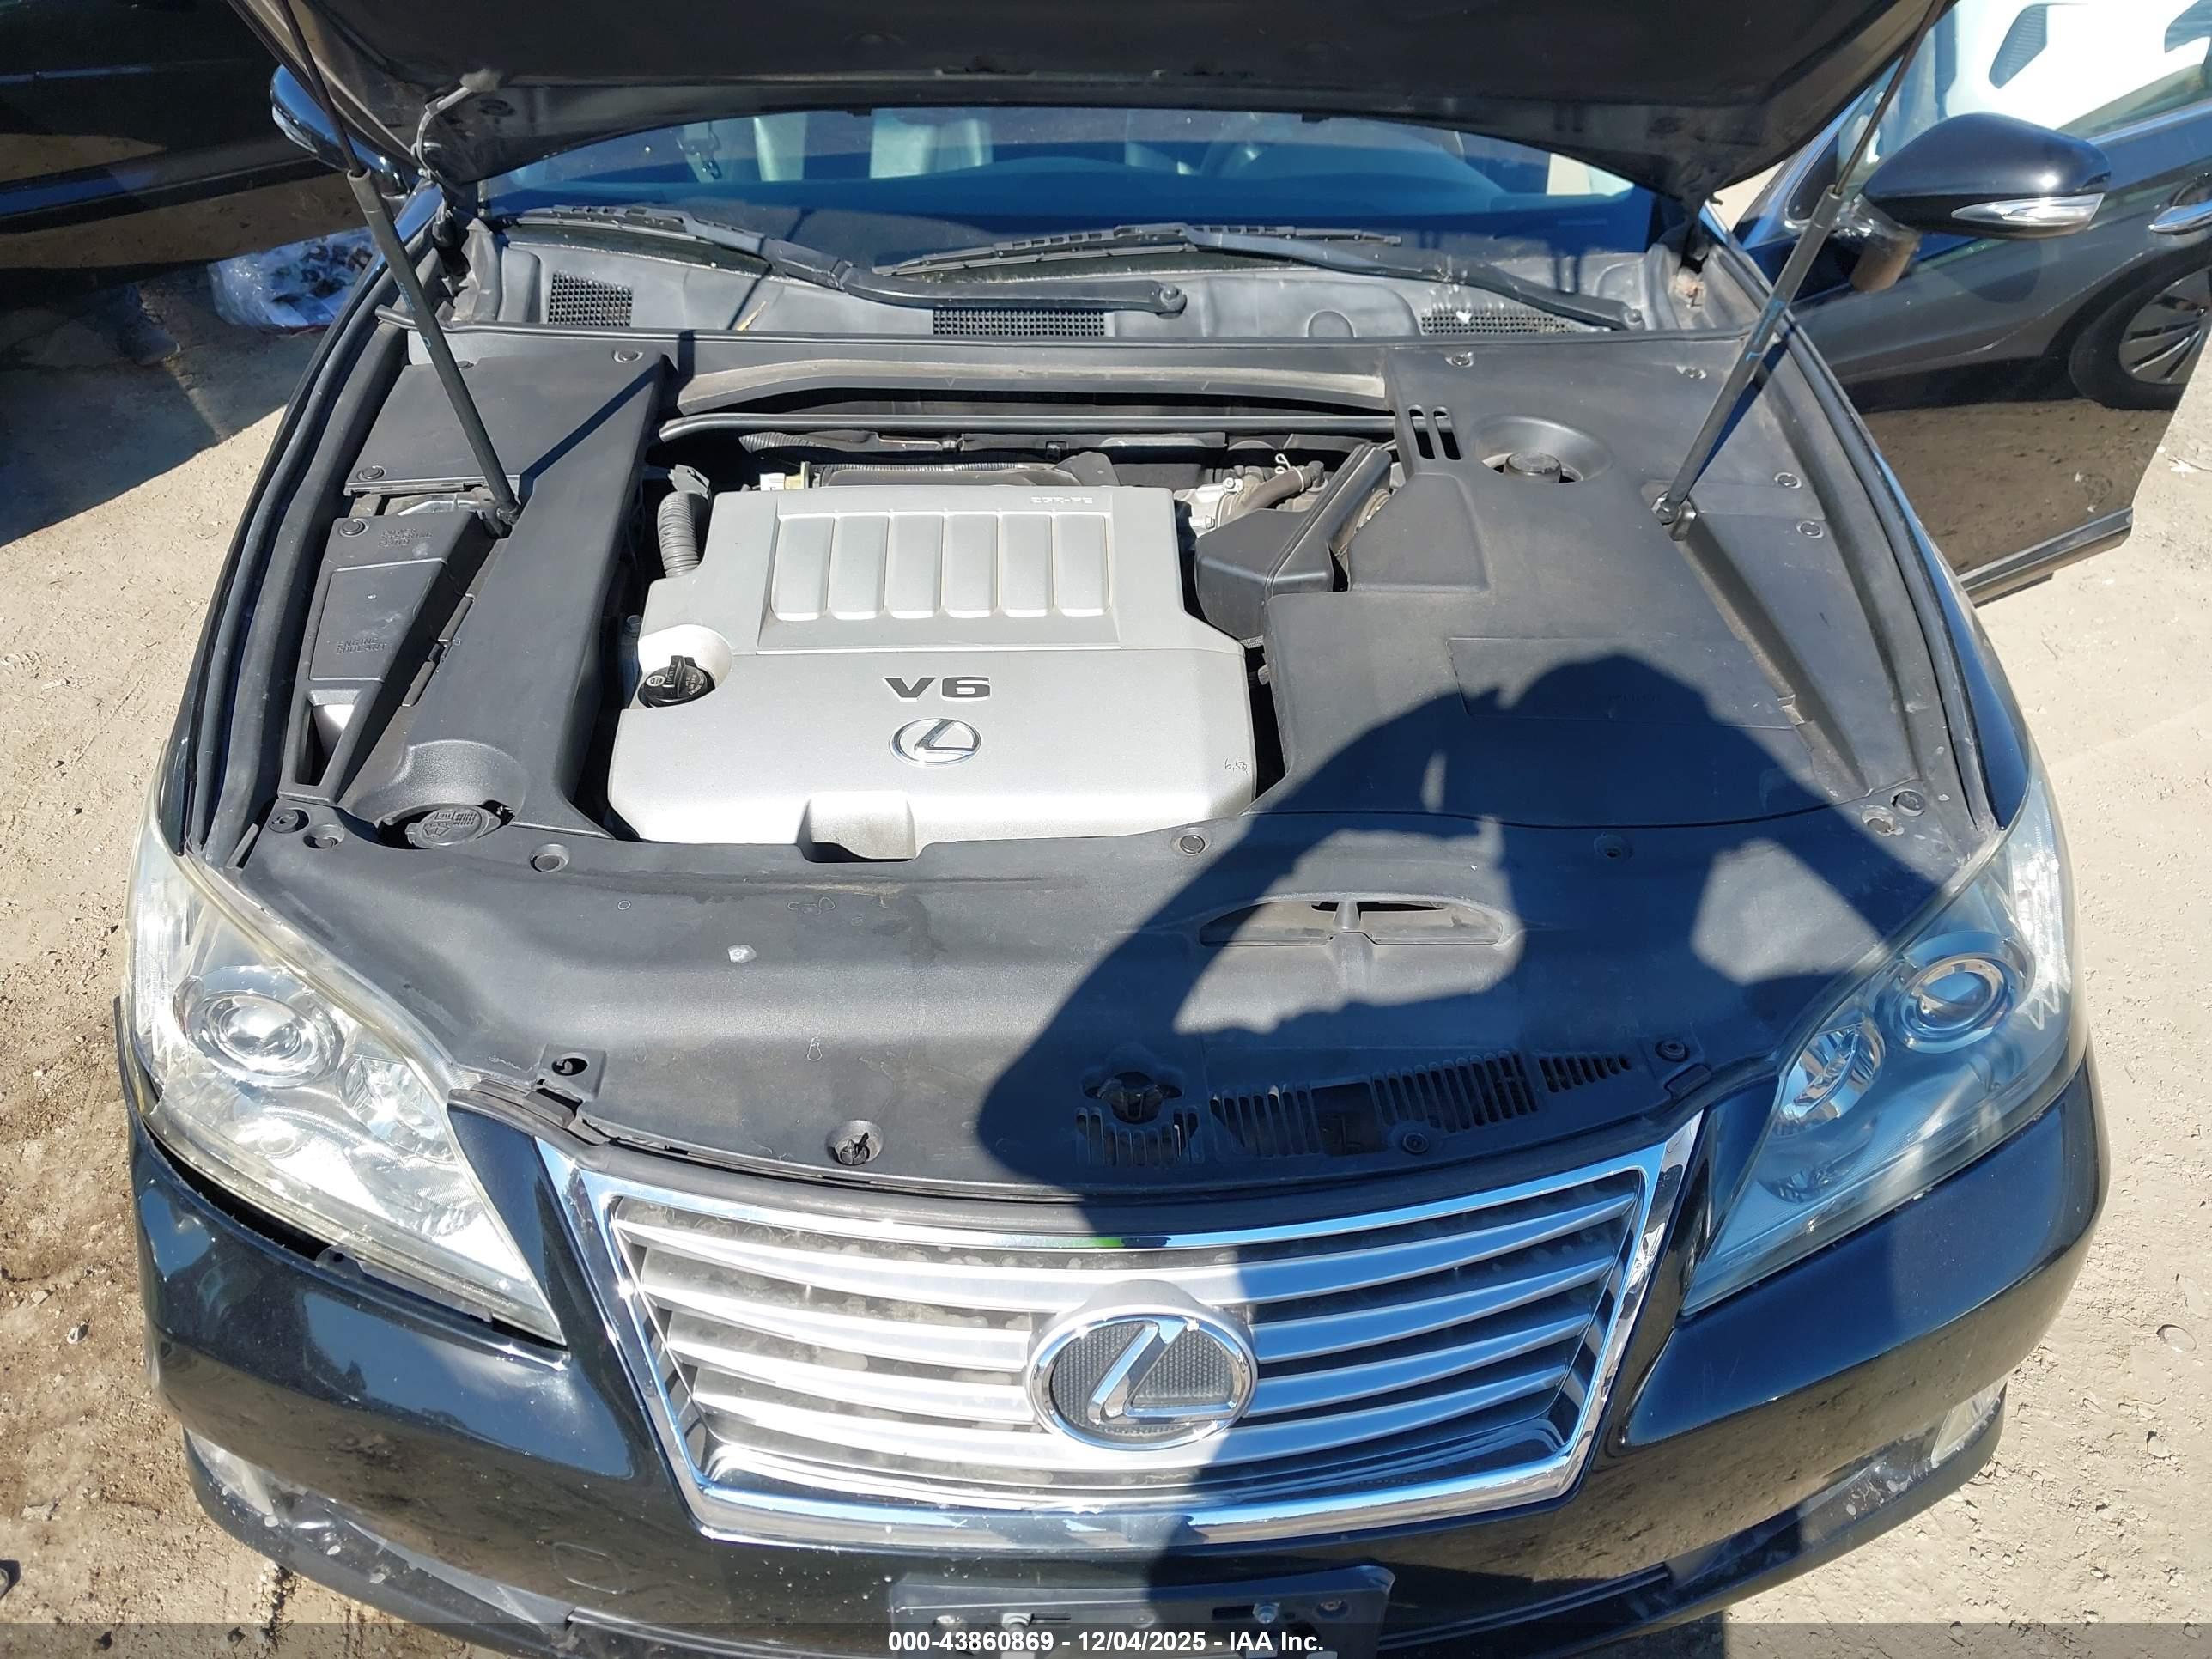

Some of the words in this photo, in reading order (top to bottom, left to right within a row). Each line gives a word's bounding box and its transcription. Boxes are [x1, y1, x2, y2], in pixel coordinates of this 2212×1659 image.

[335, 642, 388, 655] COOLANT
[336, 637, 379, 648] ENGINE
[884, 676, 992, 701] V6
